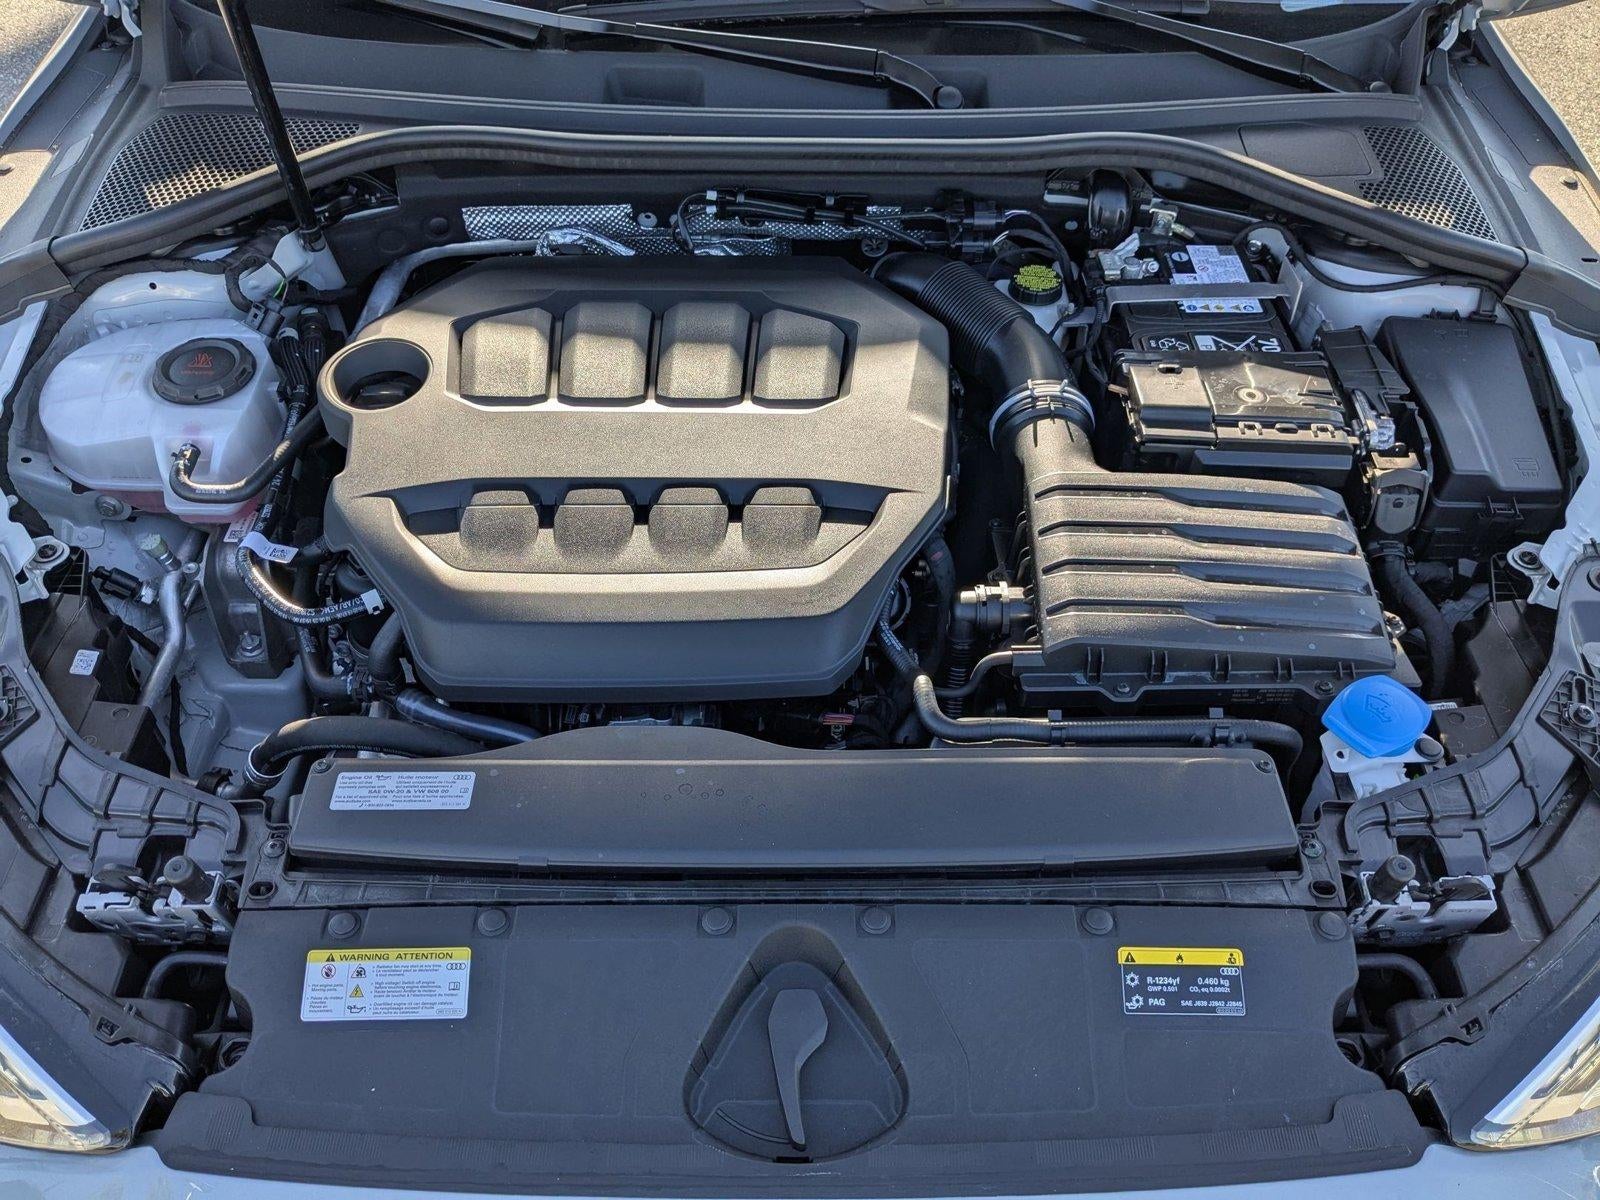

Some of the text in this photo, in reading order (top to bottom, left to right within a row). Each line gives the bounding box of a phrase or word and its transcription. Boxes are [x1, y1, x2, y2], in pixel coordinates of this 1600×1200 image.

[339, 952, 454, 961] WARNING ATTENTION
[1147, 976, 1230, 986] R-1234yf 0.460 kg
